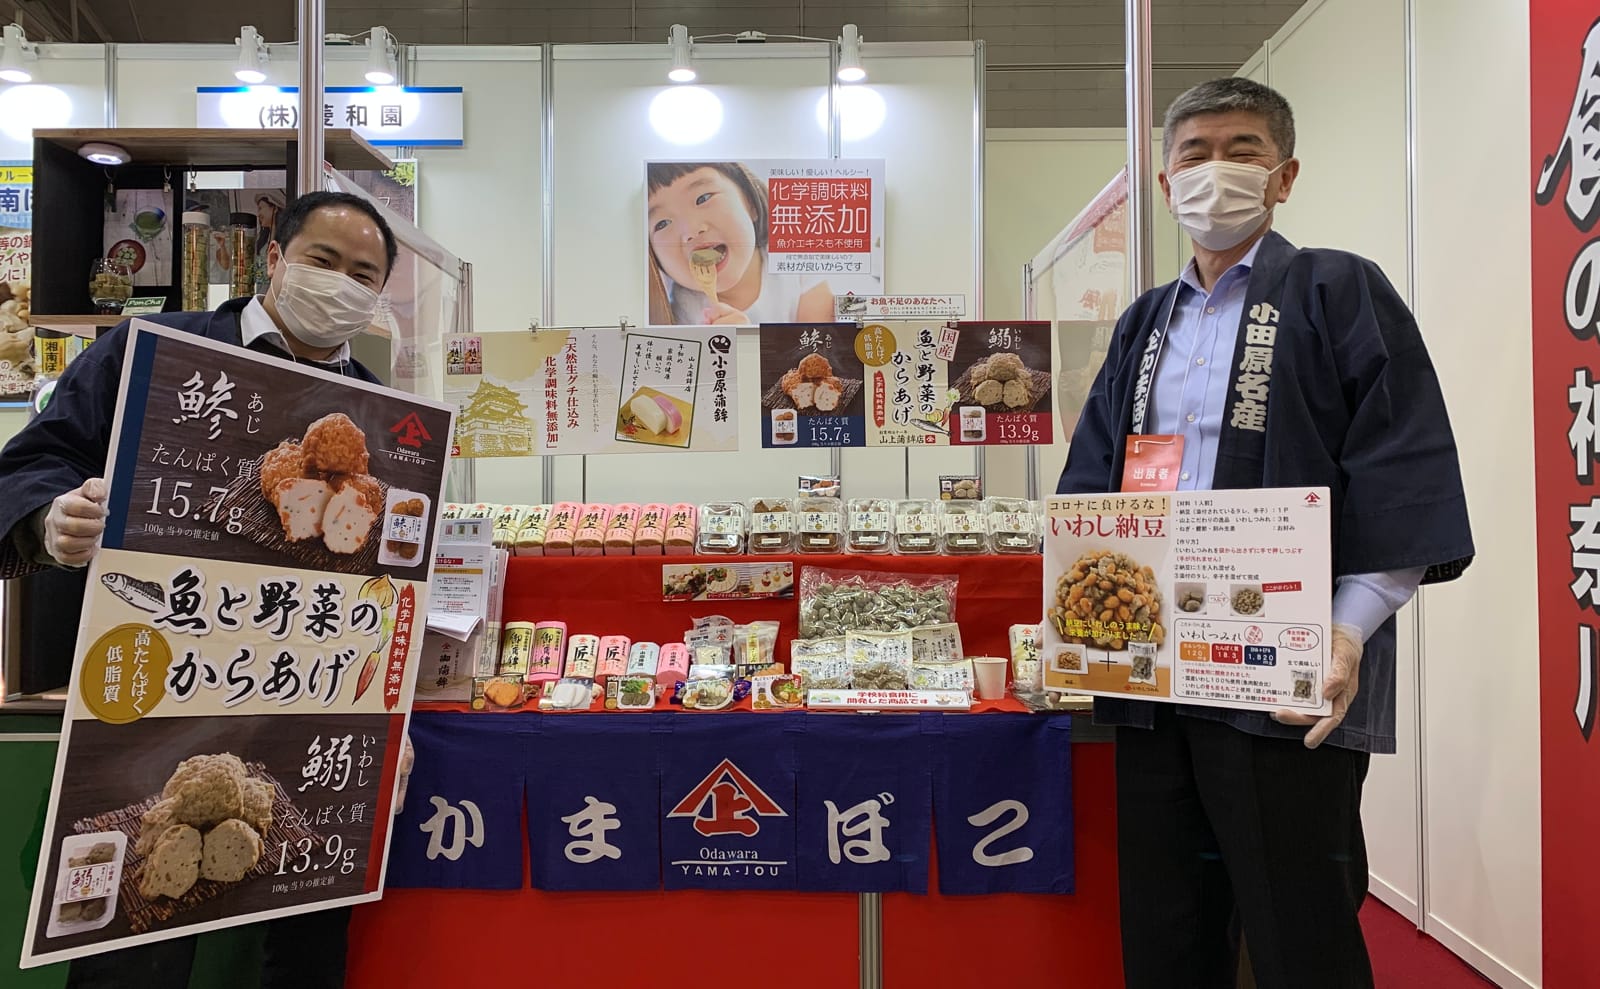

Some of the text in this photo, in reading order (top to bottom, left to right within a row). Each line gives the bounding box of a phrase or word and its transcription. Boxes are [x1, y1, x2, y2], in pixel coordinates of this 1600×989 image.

[771, 182, 869, 201] 化学調味料
[771, 204, 868, 235] 無添加
[777, 239, 863, 248] 魚介エキスも不使用
[777, 262, 863, 271] 素材が良いからです
[871, 297, 952, 306] お魚不足のあなたへ！
[825, 333, 834, 349] あじ
[939, 328, 956, 358] 国産
[1014, 328, 1022, 350] いわし
[914, 329, 937, 413] 魚と野菜の
[1230, 302, 1280, 432] 小田原名産
[712, 356, 729, 423] 小田原蒲鉾
[892, 352, 915, 426] からあげ
[246, 391, 264, 434] あじ
[545, 356, 558, 448] 化学調味料無添加」
[808, 416, 849, 426] たんぱく質
[996, 414, 1037, 423] たんぱく質
[810, 427, 850, 443] 15.7g
[999, 424, 1039, 441] 13.9g
[151, 442, 257, 480] たんぱく質
[1133, 467, 1169, 480] 出展者
[145, 476, 245, 535] 15.7g
[1049, 497, 1168, 512] コロナに負けるな！
[143, 522, 219, 542] 100g 当りの推定値
[1050, 513, 1167, 538] いわし納豆
[154, 569, 378, 636] 魚と野菜の
[386, 595, 411, 697] 化学調味料無添加
[1180, 629, 1243, 642] いわしつみれ
[574, 645, 589, 662] 匠
[605, 646, 621, 662] 匠
[103, 646, 123, 705] 低脂質
[130, 629, 151, 714] 高たんぱく
[170, 649, 355, 703] からあげ
[356, 734, 375, 787] いわし
[279, 801, 367, 831] たんぱく質
[274, 833, 356, 876] 13.9g
[700, 847, 759, 860] Odawara
[681, 864, 781, 875] YAMA-JOU
[271, 875, 336, 894] 100g 当りの推定値
